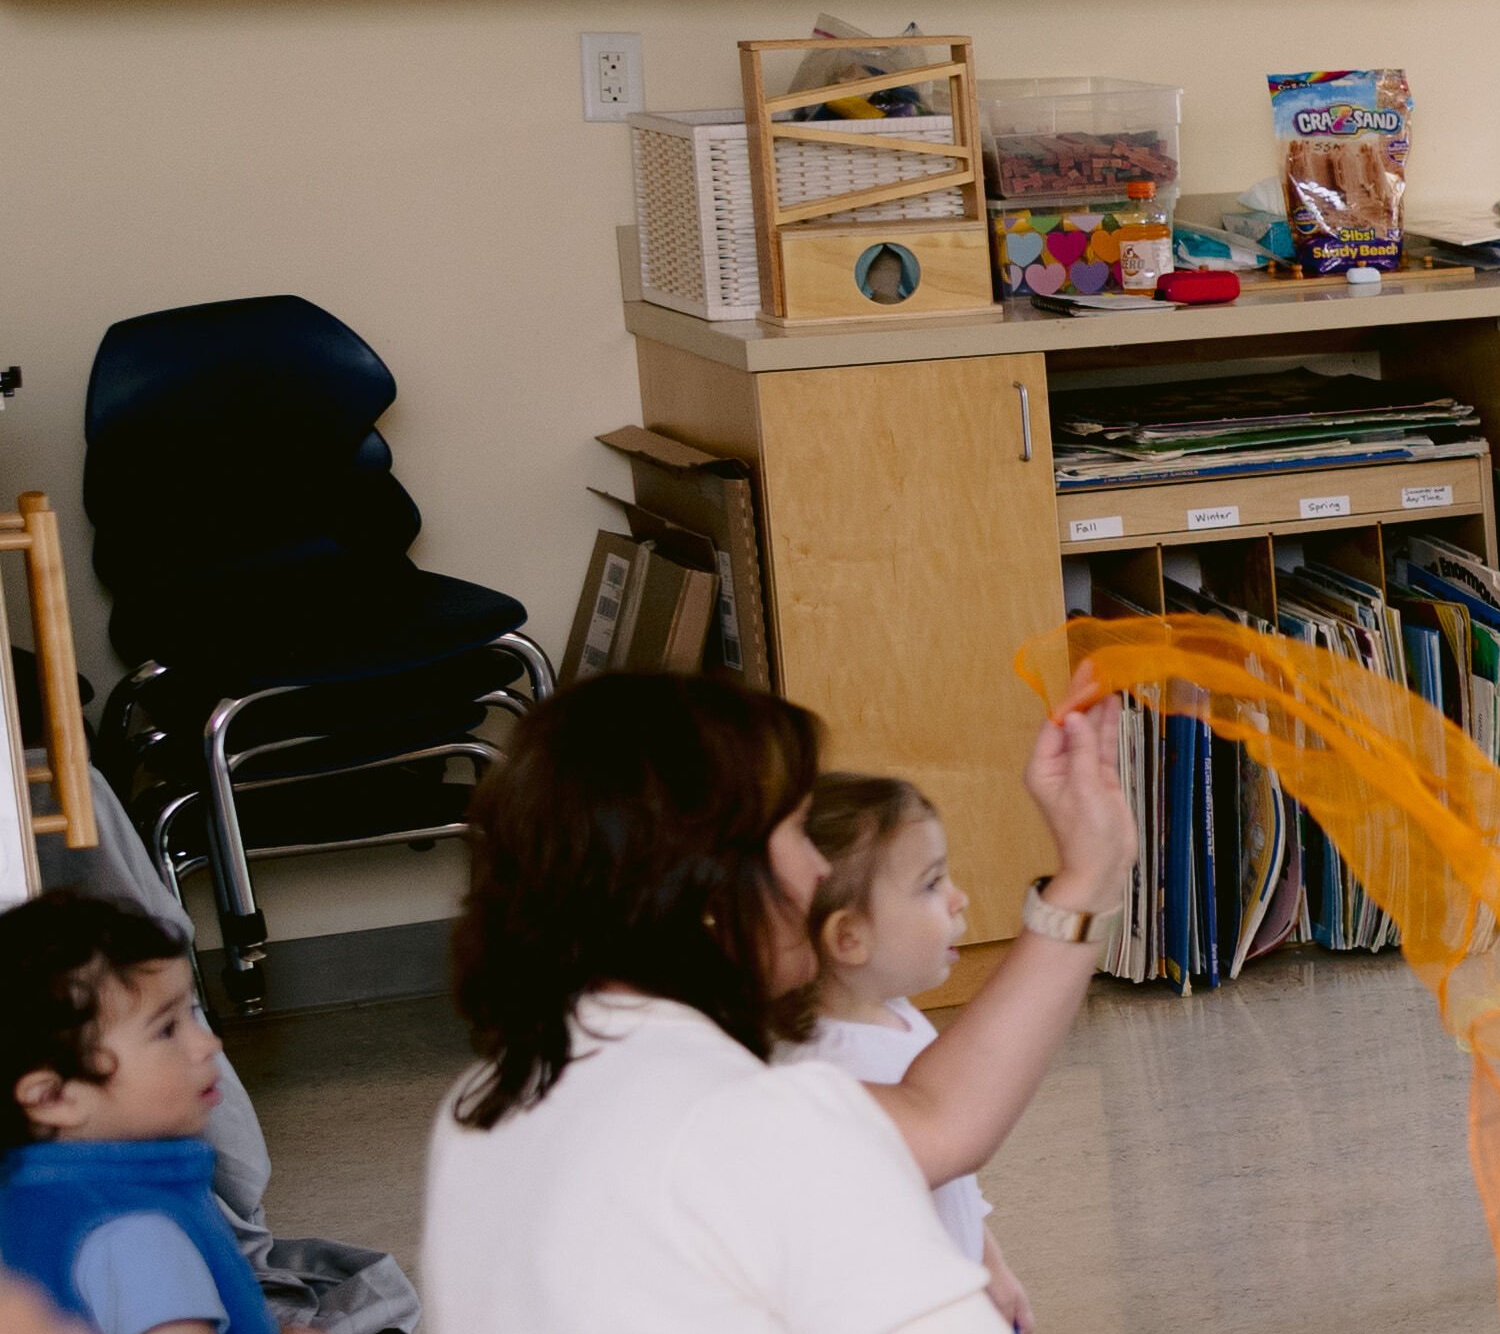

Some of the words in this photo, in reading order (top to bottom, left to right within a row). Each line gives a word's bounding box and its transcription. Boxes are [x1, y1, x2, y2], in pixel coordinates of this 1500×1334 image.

[1308, 502, 1341, 514] Spring
[1195, 510, 1232, 523] Winter
[1075, 522, 1097, 534] Fall
